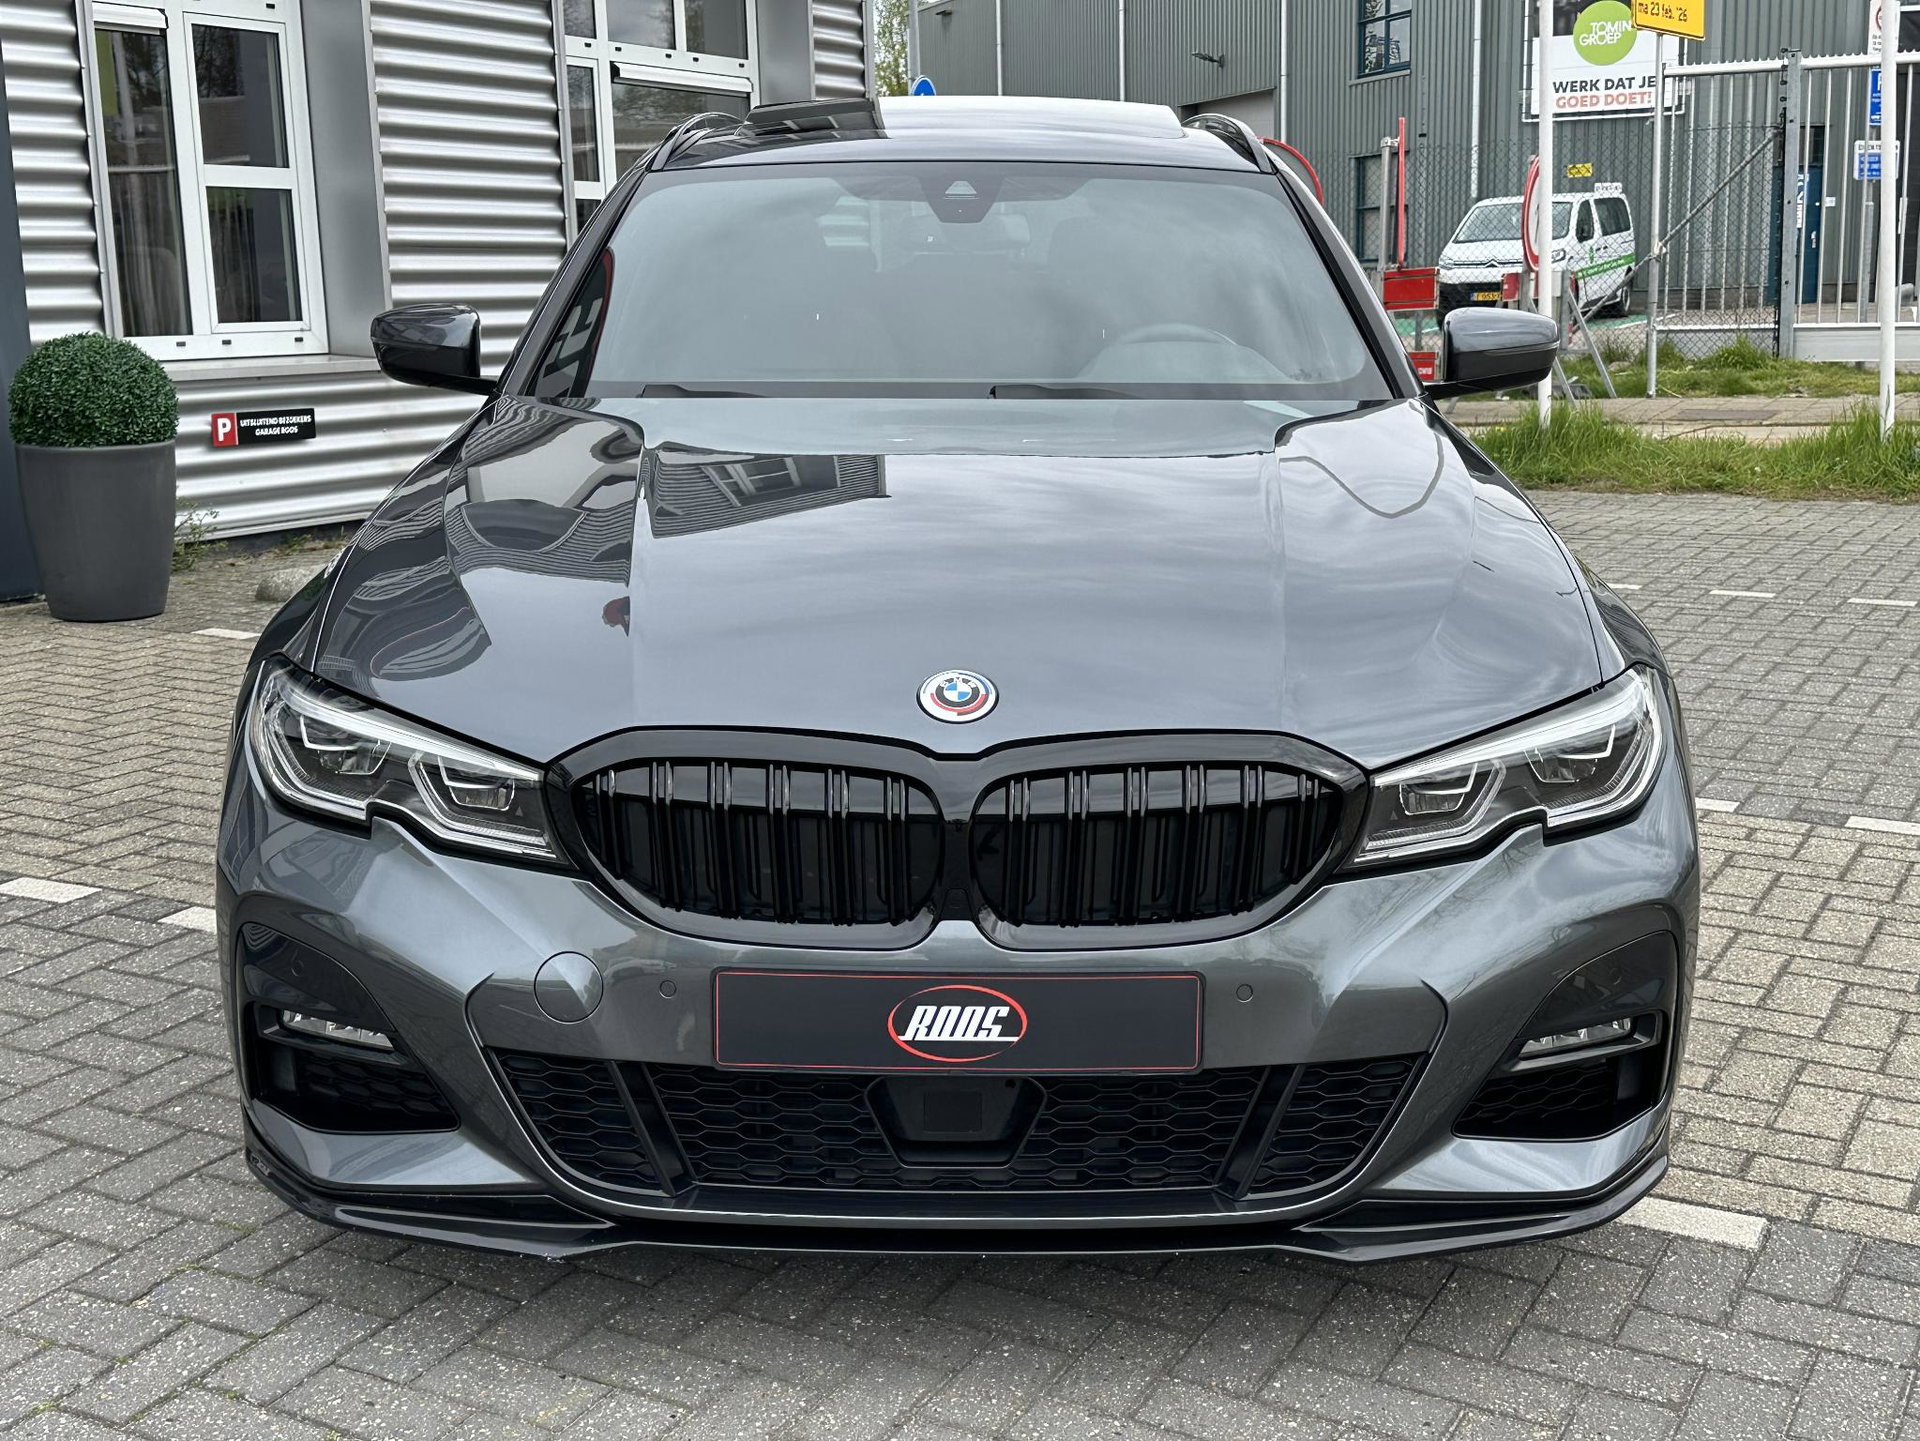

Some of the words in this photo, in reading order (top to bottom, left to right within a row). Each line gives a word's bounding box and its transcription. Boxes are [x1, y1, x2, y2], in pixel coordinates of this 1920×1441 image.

[1651, 2, 1660, 16] 23
[1662, 4, 1675, 19] feb.
[1677, 7, 1688, 22] '26
[1590, 20, 1633, 35] TOMIN
[1579, 33, 1622, 46] GROEP
[1553, 78, 1600, 94] WERK
[1604, 77, 1635, 91] DAT
[1638, 76, 1656, 88] JE
[1556, 95, 1600, 109] GOED
[1604, 91, 1652, 106] DOET!
[217, 417, 231, 441] P
[240, 417, 278, 427] UITSLUITEND
[279, 415, 312, 425] BEZOEKERS
[255, 427, 280, 436] GARAGE
[281, 426, 298, 434] ROOS
[898, 1004, 1020, 1042] ROOS
